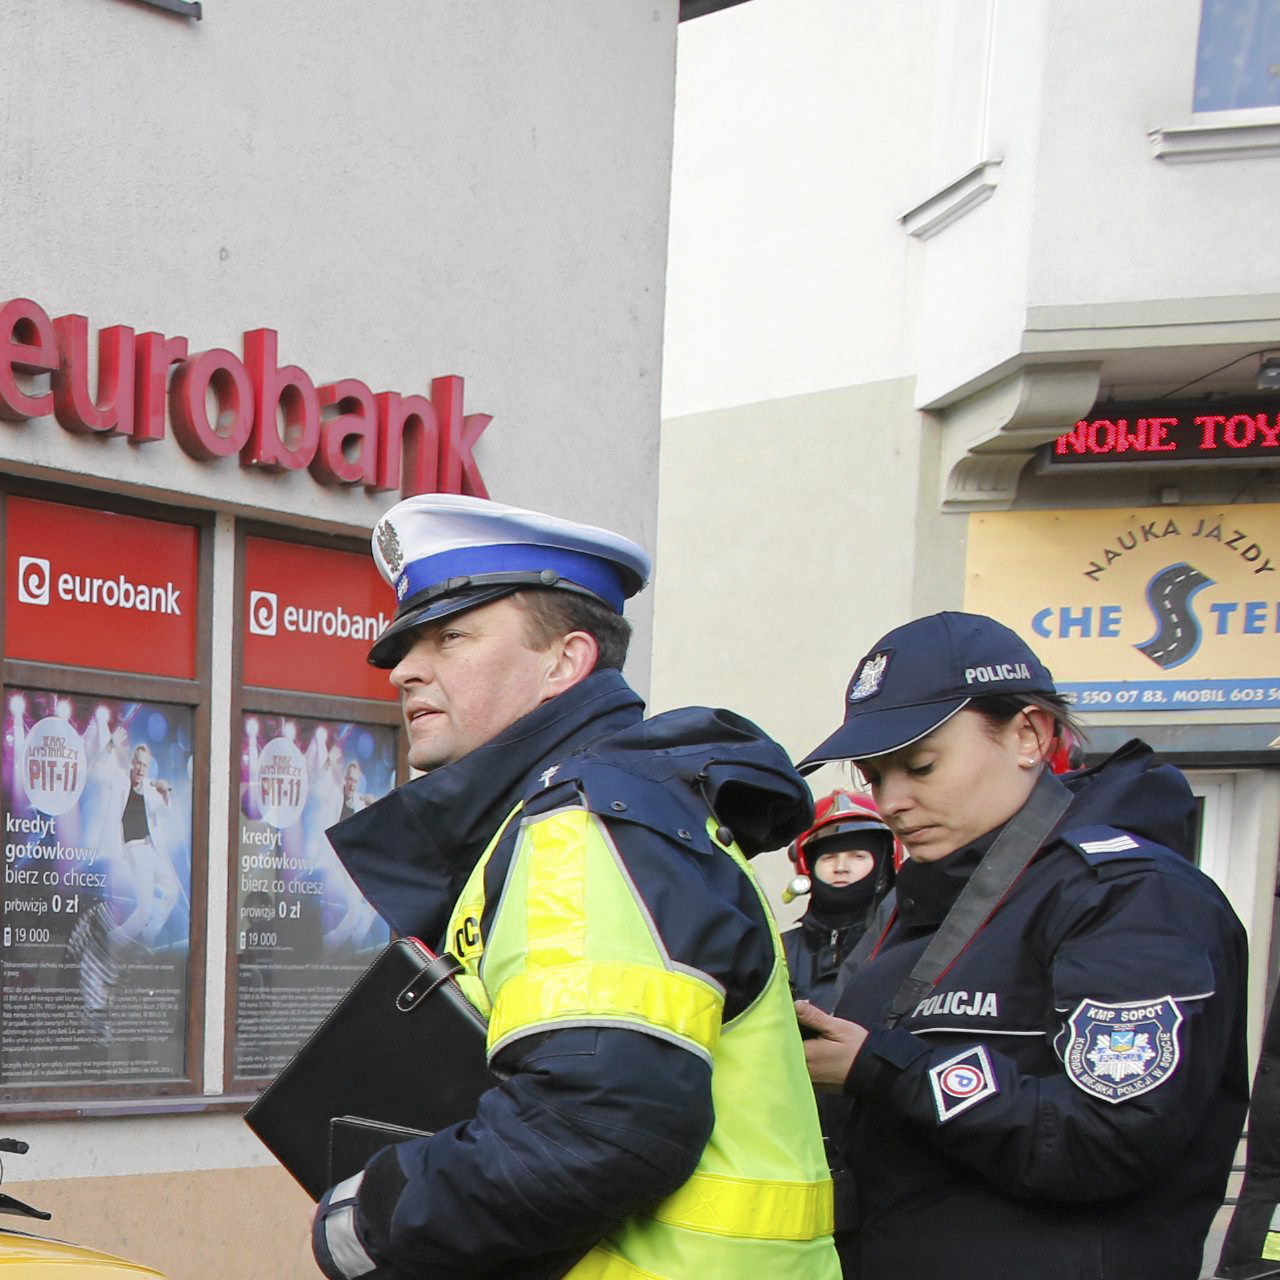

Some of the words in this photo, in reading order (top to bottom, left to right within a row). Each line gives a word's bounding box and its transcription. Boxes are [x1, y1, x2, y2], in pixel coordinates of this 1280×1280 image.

[1056, 417, 1178, 454] NOWE
[1083, 518, 1181, 581] NAUKA
[1192, 518, 1275, 575] JAZDY
[57, 572, 182, 616] eurobank
[283, 606, 391, 641] eurobank
[965, 663, 1031, 684] POLICJA
[1082, 690, 1111, 704] 550
[1116, 690, 1138, 703] 07
[1173, 689, 1226, 703] MOBIL
[1230, 688, 1264, 701] 603
[29, 759, 78, 792] PIT-11
[261, 777, 301, 806] PIT-11
[5, 812, 56, 839] kredyt
[242, 826, 283, 850] kredyt
[5, 840, 97, 867] gotówkowy
[242, 853, 317, 875] gotówkowy
[5, 864, 38, 885] bierz
[43, 871, 59, 886] co
[63, 868, 107, 888] chcesz
[241, 875, 268, 893] bierz
[271, 880, 284, 893] co
[288, 877, 324, 895] chcesz
[4, 898, 48, 915] prowizja
[52, 894, 61, 912] 0
[65, 894, 79, 913] zł
[240, 905, 275, 920] prowizja
[278, 901, 287, 918] 0
[289, 901, 301, 918] zł
[14, 928, 26, 943] 19
[29, 928, 50, 943] 000
[249, 932, 259, 945] 19
[261, 932, 277, 945] 000
[911, 990, 998, 1018] POLICJA
[1086, 1006, 1116, 1021] KMP
[1121, 1005, 1163, 1021] SOPOT
[1070, 1037, 1086, 1075] KOMENDA
[1080, 1073, 1113, 1096] MIEJSKA
[1117, 1077, 1153, 1096] POLICJI
[1151, 1067, 1164, 1078] W
[1160, 1032, 1171, 1068] SOPOCIE
